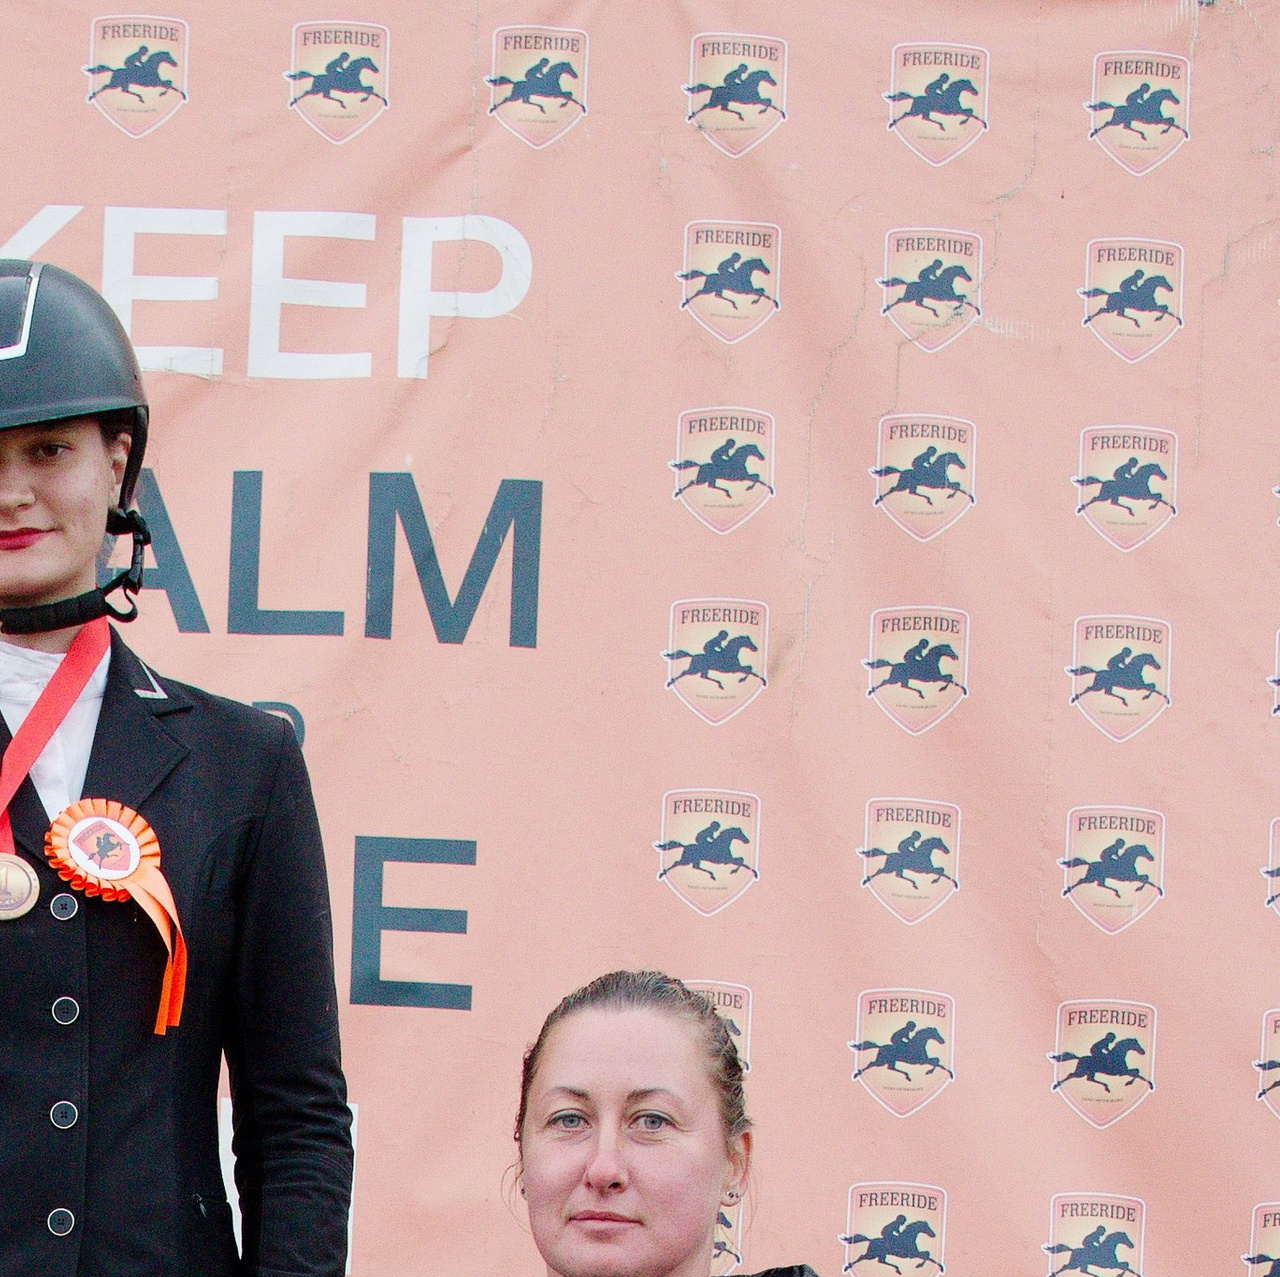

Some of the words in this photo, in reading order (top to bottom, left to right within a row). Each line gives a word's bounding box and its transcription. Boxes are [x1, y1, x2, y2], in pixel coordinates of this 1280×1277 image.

[100, 25, 180, 44] FREERIDE
[302, 30, 381, 48] FREERIDE
[503, 35, 580, 52] FREERIDE
[701, 42, 778, 60] FREERIDE
[902, 52, 980, 70] FREERIDE
[1103, 61, 1181, 79] FREERIDE
[695, 230, 772, 249] FREERIDE
[895, 238, 973, 256] FREERIDE
[1097, 248, 1175, 266] FREERIDE
[688, 417, 766, 435] FREERIDE
[888, 425, 967, 443] FREERIDE
[1090, 436, 1168, 454] FREERIDE
[681, 608, 759, 626] FREERIDE
[881, 616, 960, 634] FREERIDE
[1084, 625, 1162, 644] FREERIDE
[673, 799, 751, 817] FREERIDE
[876, 807, 951, 826] FREERIDE
[1077, 816, 1156, 835] FREERIDE
[868, 998, 946, 1017] FREERIDE
[1067, 1009, 1147, 1028] FREERIDE
[859, 1192, 937, 1211] FREERIDE
[1060, 1203, 1136, 1221] FREERIDE
